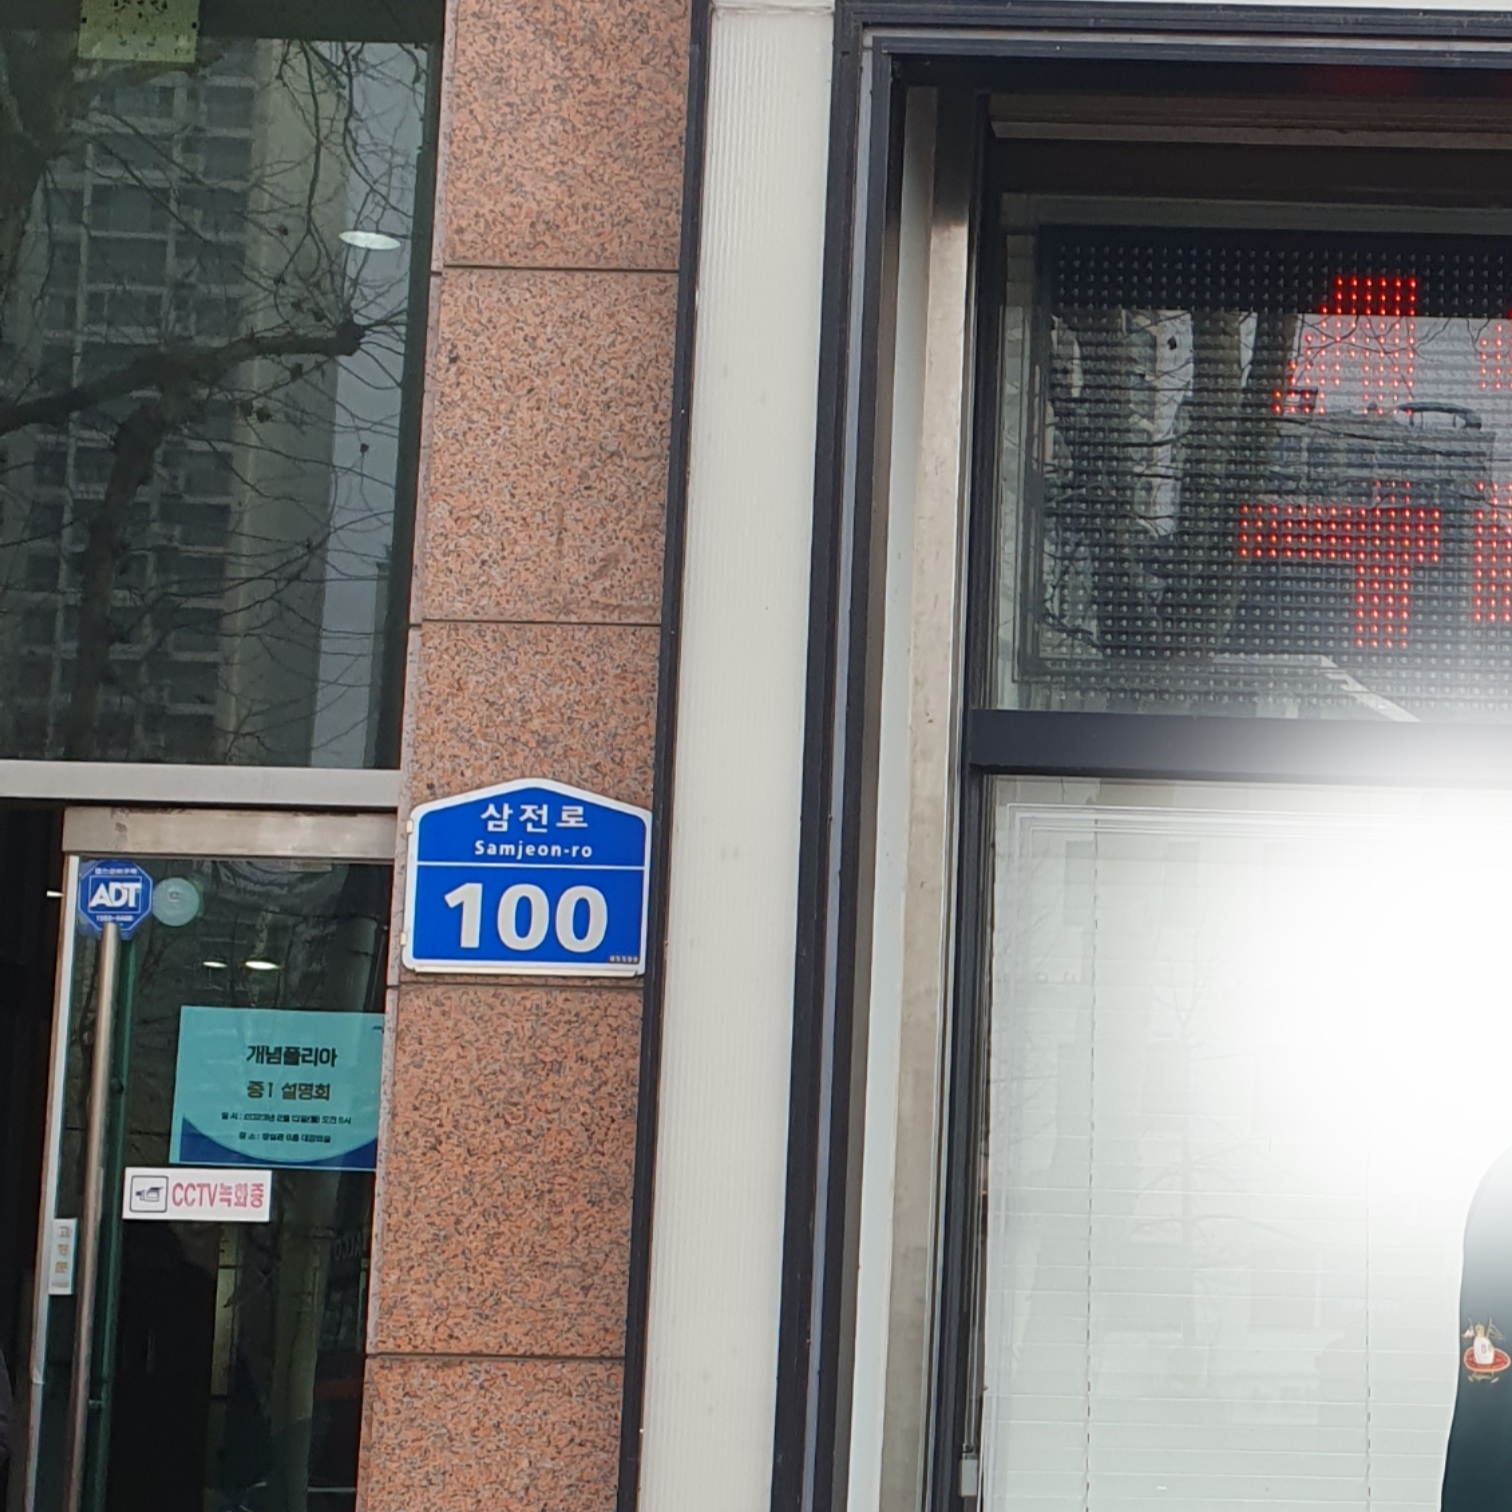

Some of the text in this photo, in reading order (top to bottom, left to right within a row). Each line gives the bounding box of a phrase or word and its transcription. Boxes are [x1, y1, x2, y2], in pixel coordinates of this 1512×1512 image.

[480, 802, 589, 833] 삼전로
[474, 840, 593, 860] Samjeon-ro
[88, 881, 142, 908] ADT
[444, 882, 608, 953] 100
[281, 1082, 331, 1101] 설명회
